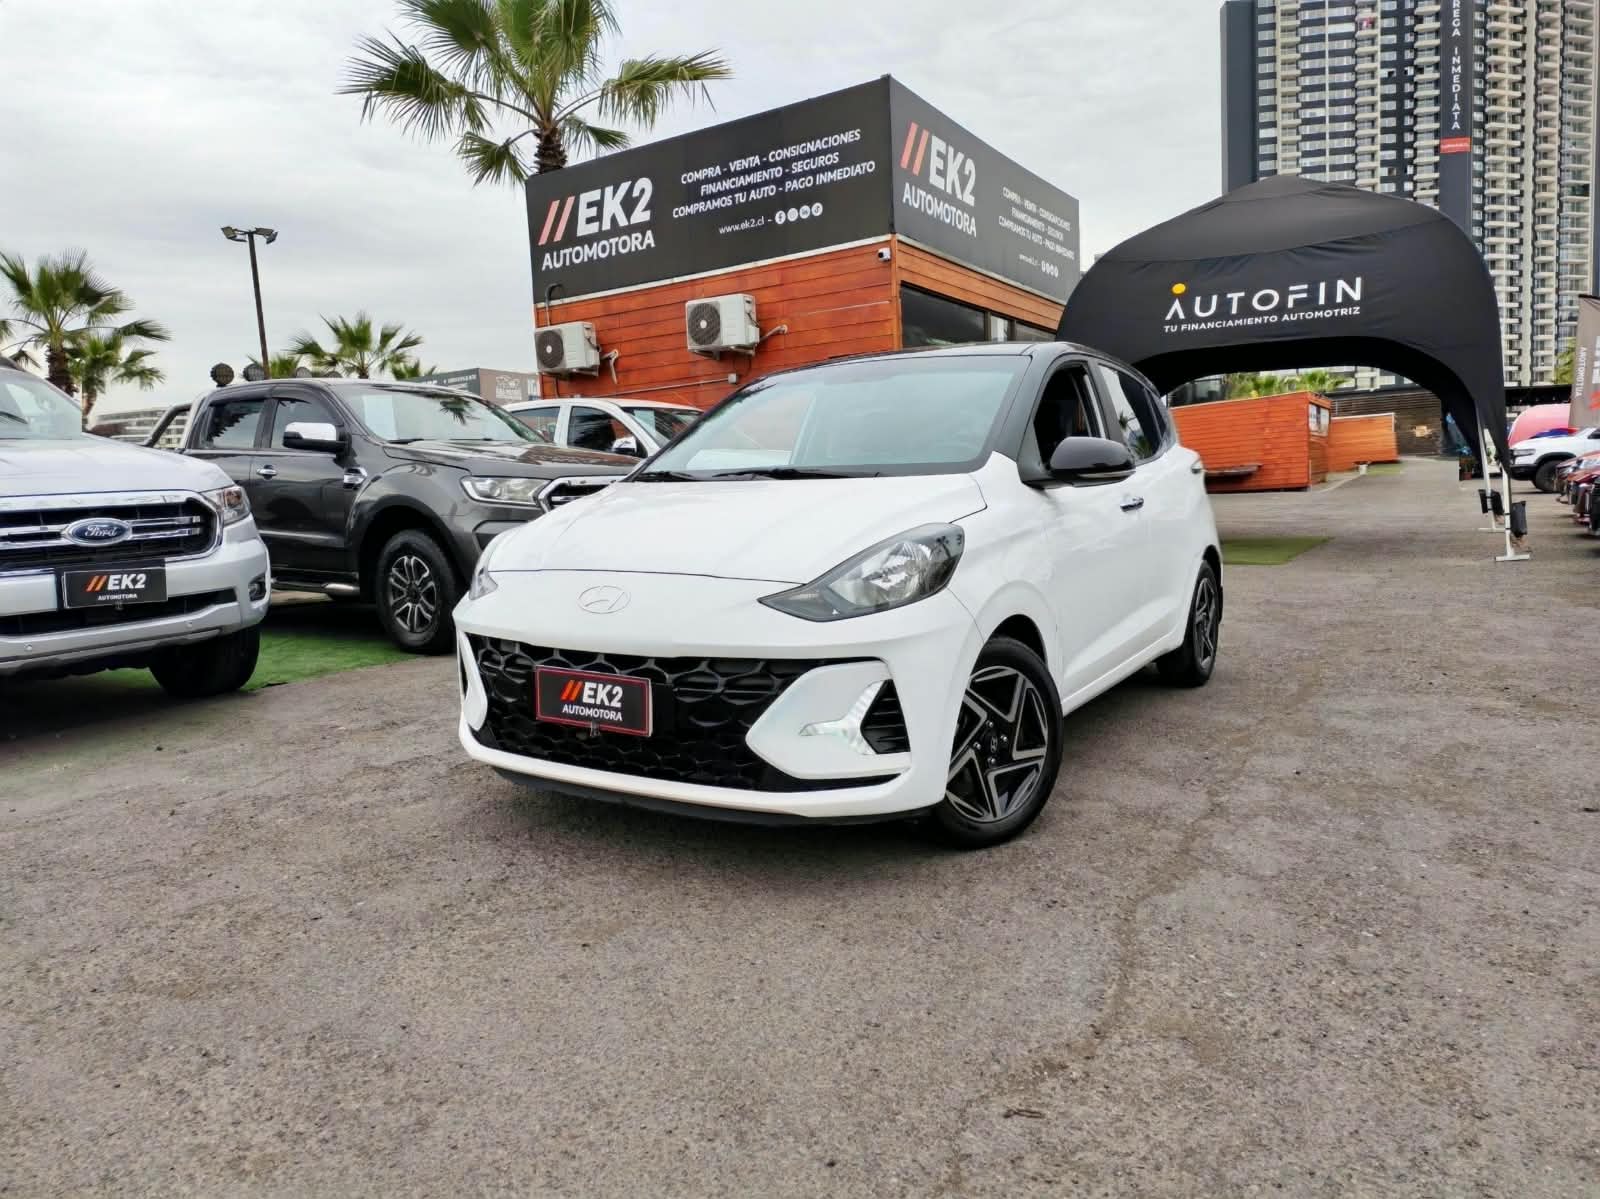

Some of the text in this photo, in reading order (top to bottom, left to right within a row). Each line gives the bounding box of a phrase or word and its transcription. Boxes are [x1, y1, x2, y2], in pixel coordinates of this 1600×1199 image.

[1451, 47, 1462, 130] INMEDIATA
[681, 165, 722, 185] COMPRA
[729, 155, 761, 174] VENTA
[768, 129, 861, 163] CONSIGNACIONES
[700, 166, 783, 197] FINANCIAMIENTO
[791, 152, 840, 174] SEGUROS
[672, 195, 733, 218] COMPRAMOS
[734, 191, 747, 203] TU
[748, 185, 777, 201] AUTO
[785, 176, 814, 193] PAGO
[815, 160, 876, 186] INMEDIATO
[902, 182, 977, 238] AUTOMOTORA
[718, 215, 765, 235] www.ek2.cl
[541, 229, 656, 272] AUTOMOTORA
[1163, 306, 1361, 334] TU FINANCIAMIENTO AUTOMOTRIZ
[1164, 276, 1362, 321] AUTOFIN
[84, 524, 118, 537] Ford
[98, 593, 138, 601] AUTOMOTORA
[562, 703, 623, 722] AUTOMOTORA
